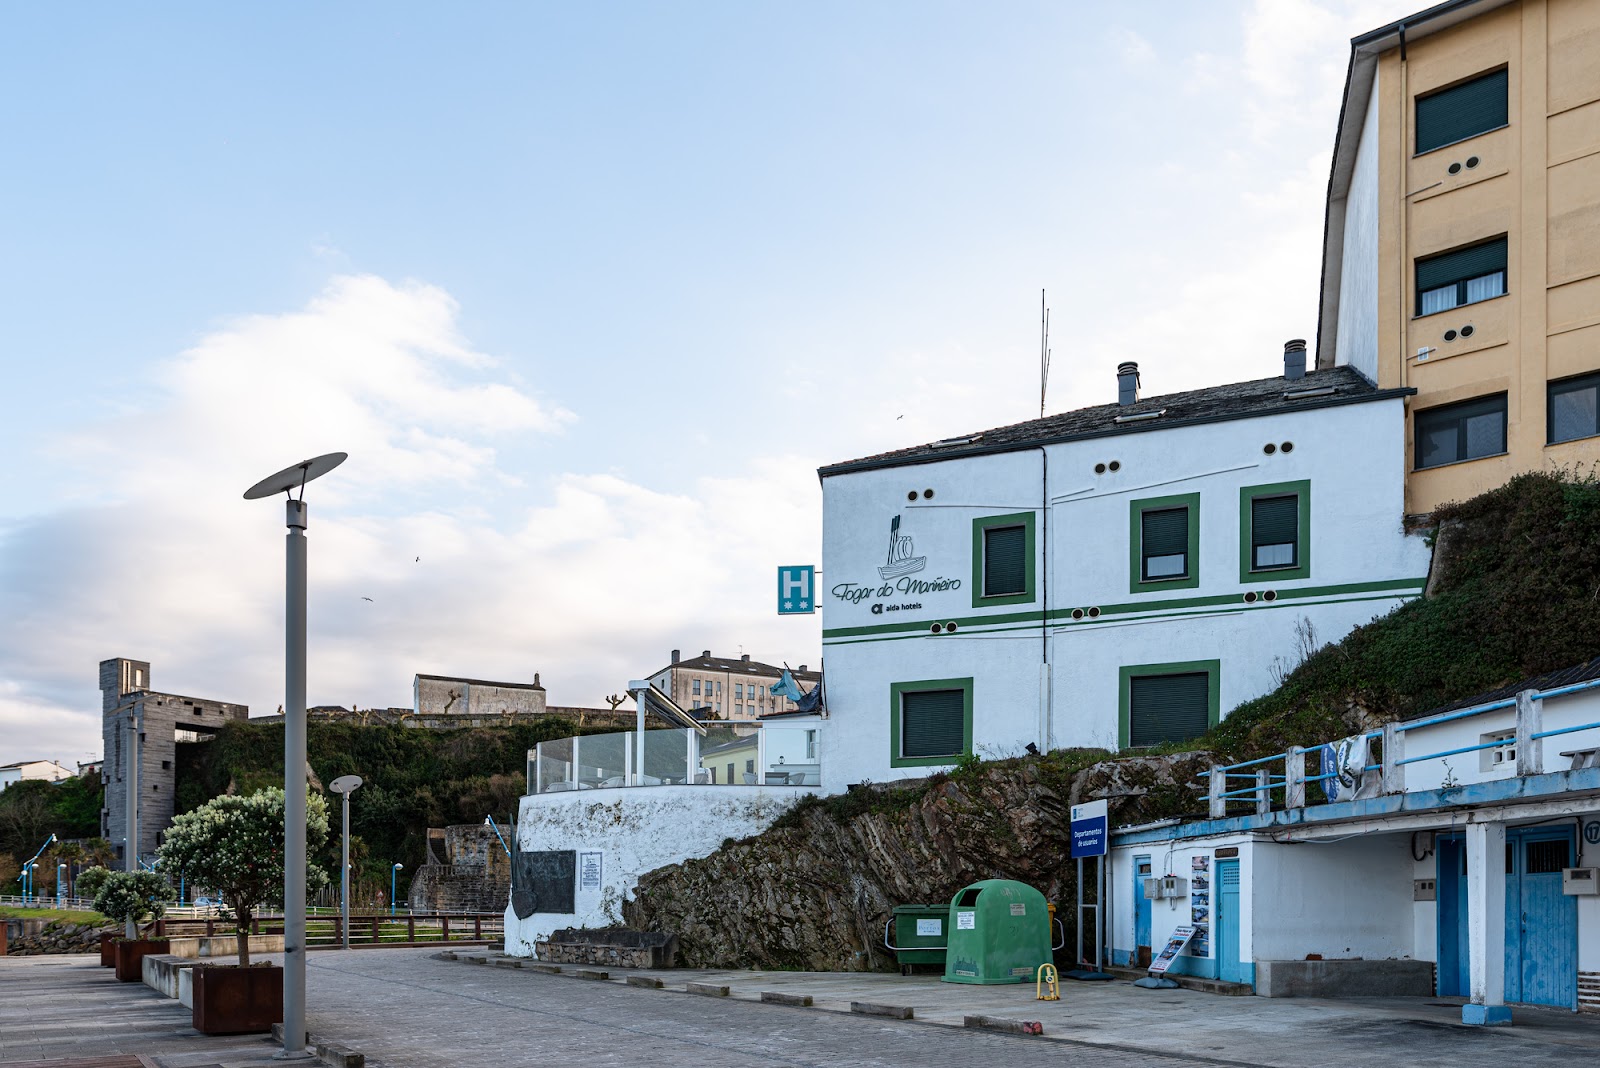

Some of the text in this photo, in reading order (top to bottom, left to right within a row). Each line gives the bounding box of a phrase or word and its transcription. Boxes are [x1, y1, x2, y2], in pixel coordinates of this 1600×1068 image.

[783, 570, 808, 598] H
[877, 583, 893, 597] do
[901, 602, 922, 610] hotels
[1074, 828, 1102, 839] Departamentos
[1588, 826, 1600, 840] 17
[1083, 838, 1098, 847] usuarios
